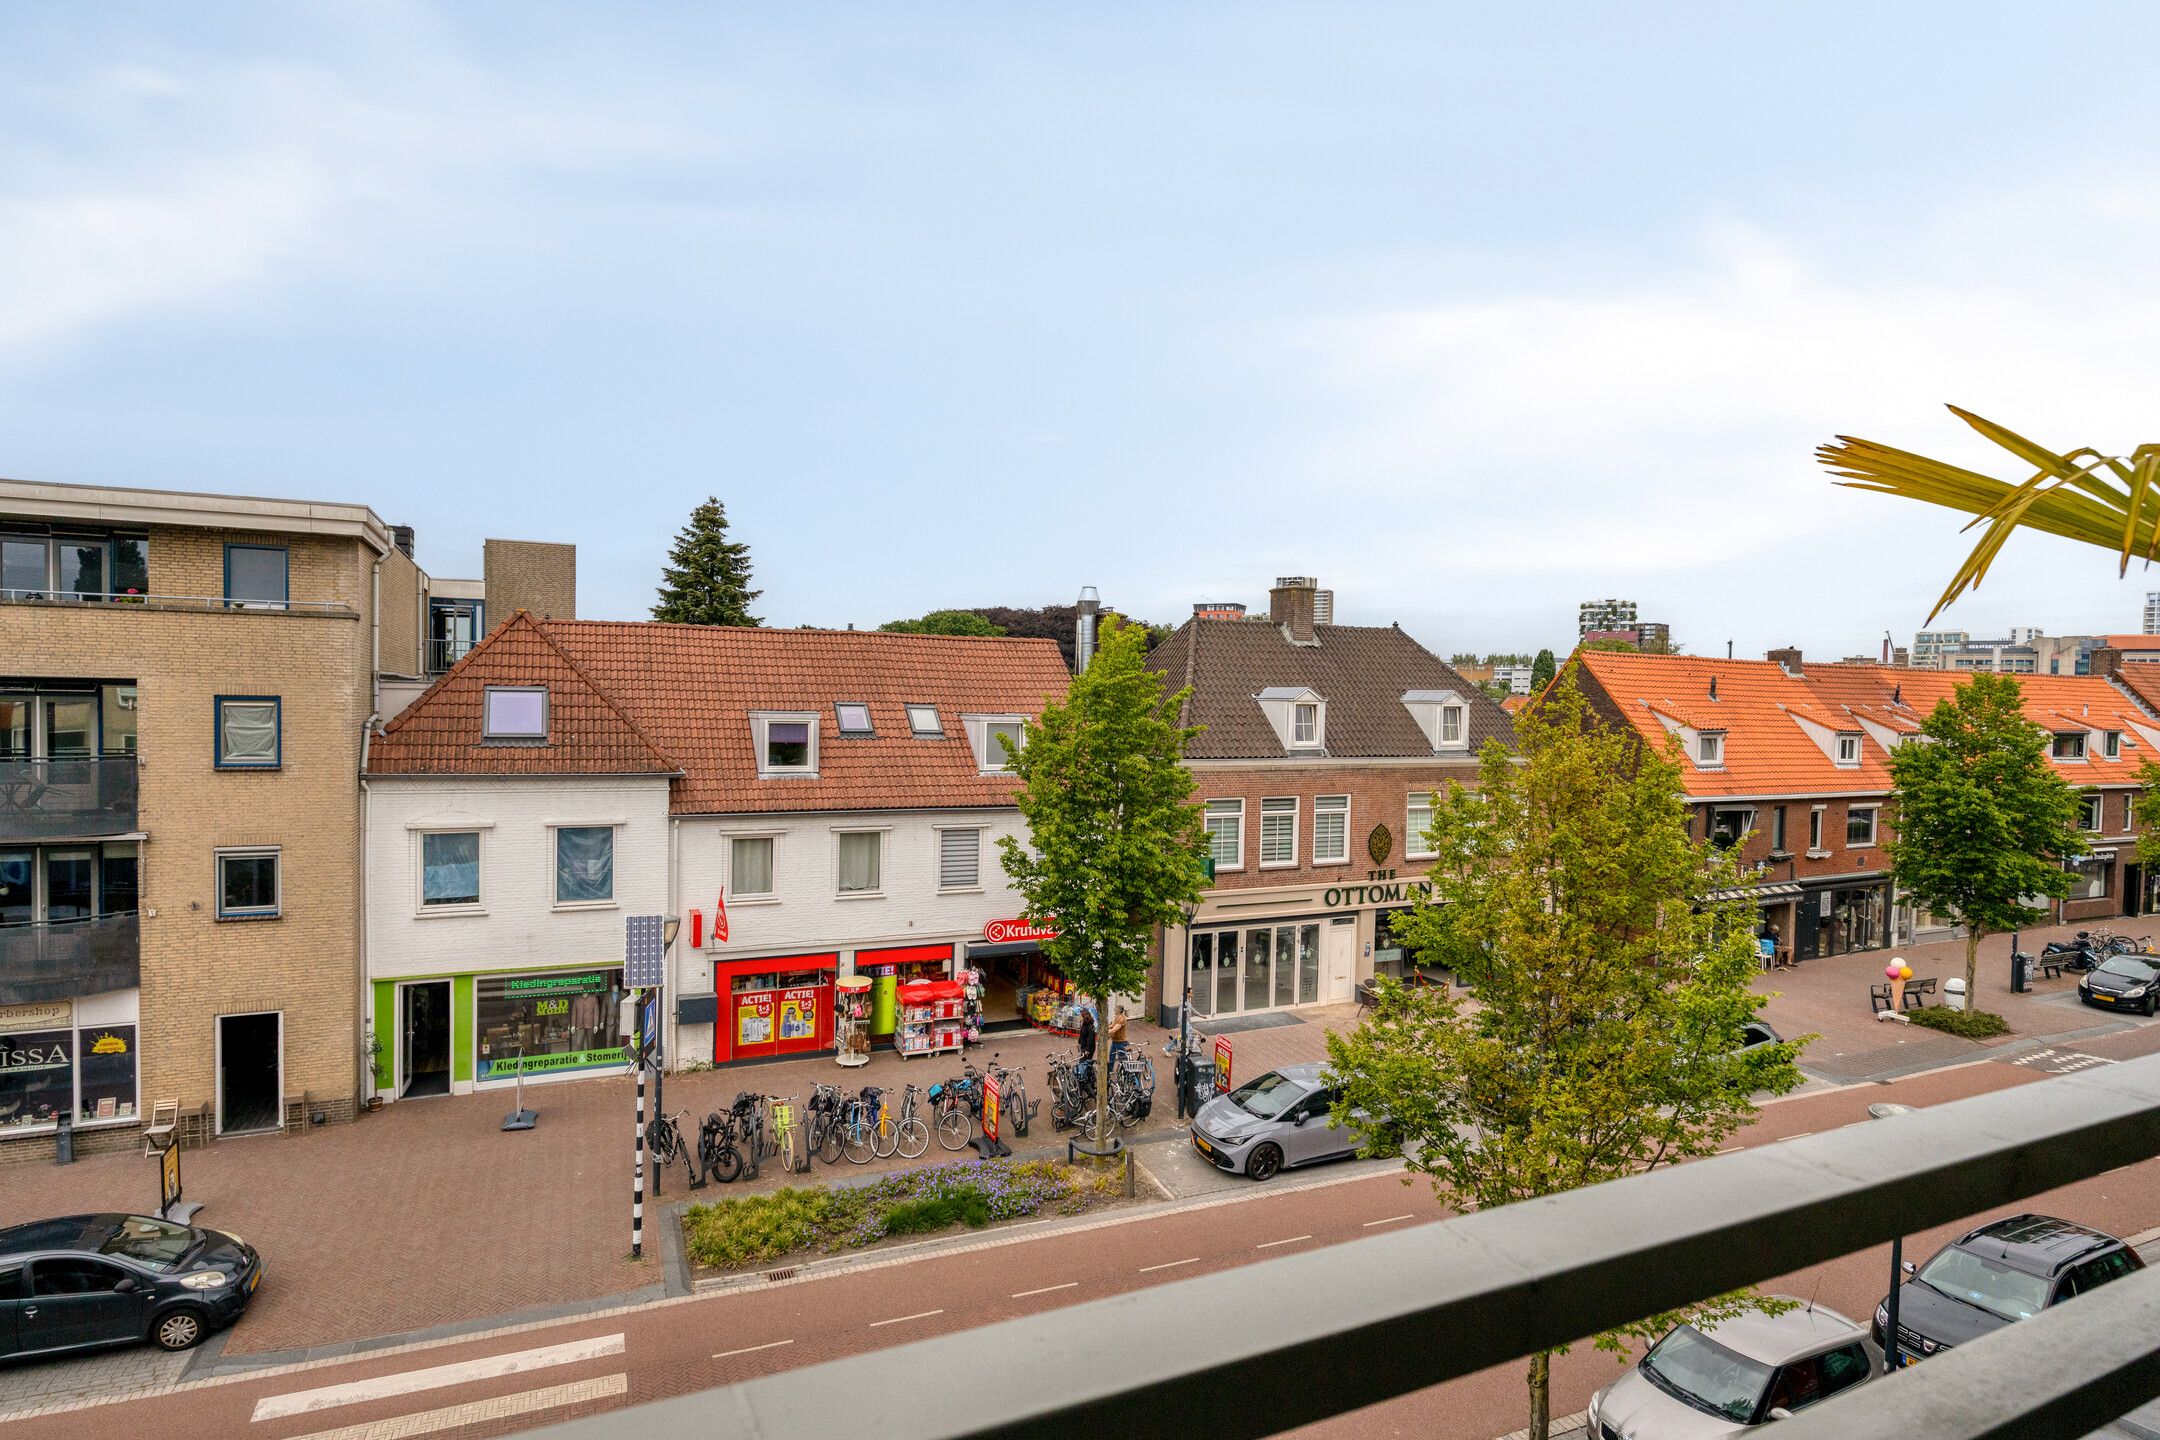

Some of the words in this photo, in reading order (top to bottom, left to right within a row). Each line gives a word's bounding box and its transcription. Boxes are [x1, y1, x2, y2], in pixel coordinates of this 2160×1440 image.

[1368, 869, 1396, 881] THE
[1006, 922, 1058, 938] Kruidva
[511, 974, 602, 989] Kledingreparatie
[741, 993, 772, 1005] ACTIE!
[784, 989, 814, 1000] ACTIE!
[536, 1006, 569, 1016] MODE
[758, 1004, 770, 1012] 1+1
[0, 1044, 70, 1068] ISSA
[496, 1055, 578, 1071] Kledngreparatie
[587, 1050, 627, 1062] Stomerij
